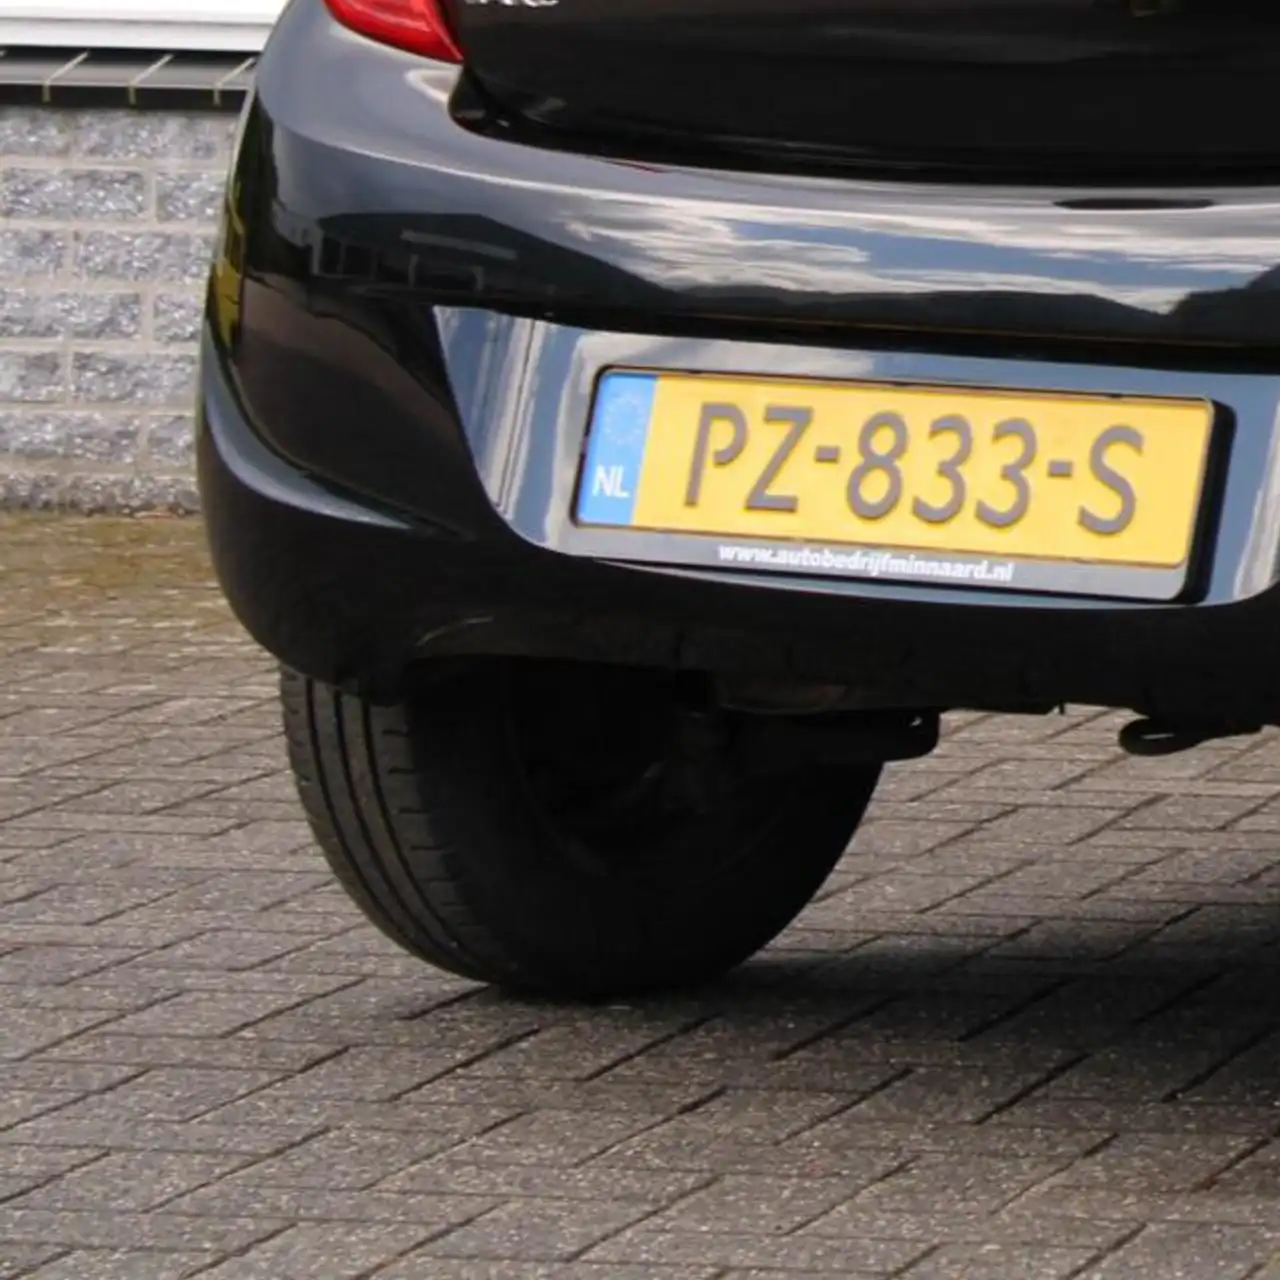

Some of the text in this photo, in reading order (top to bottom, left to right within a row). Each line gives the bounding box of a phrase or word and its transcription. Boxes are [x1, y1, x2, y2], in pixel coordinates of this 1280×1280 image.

[592, 464, 630, 498] NL
[684, 401, 1145, 535] PZ-833-S
[718, 543, 1015, 581] www.autobedrijfminnaard.nl
